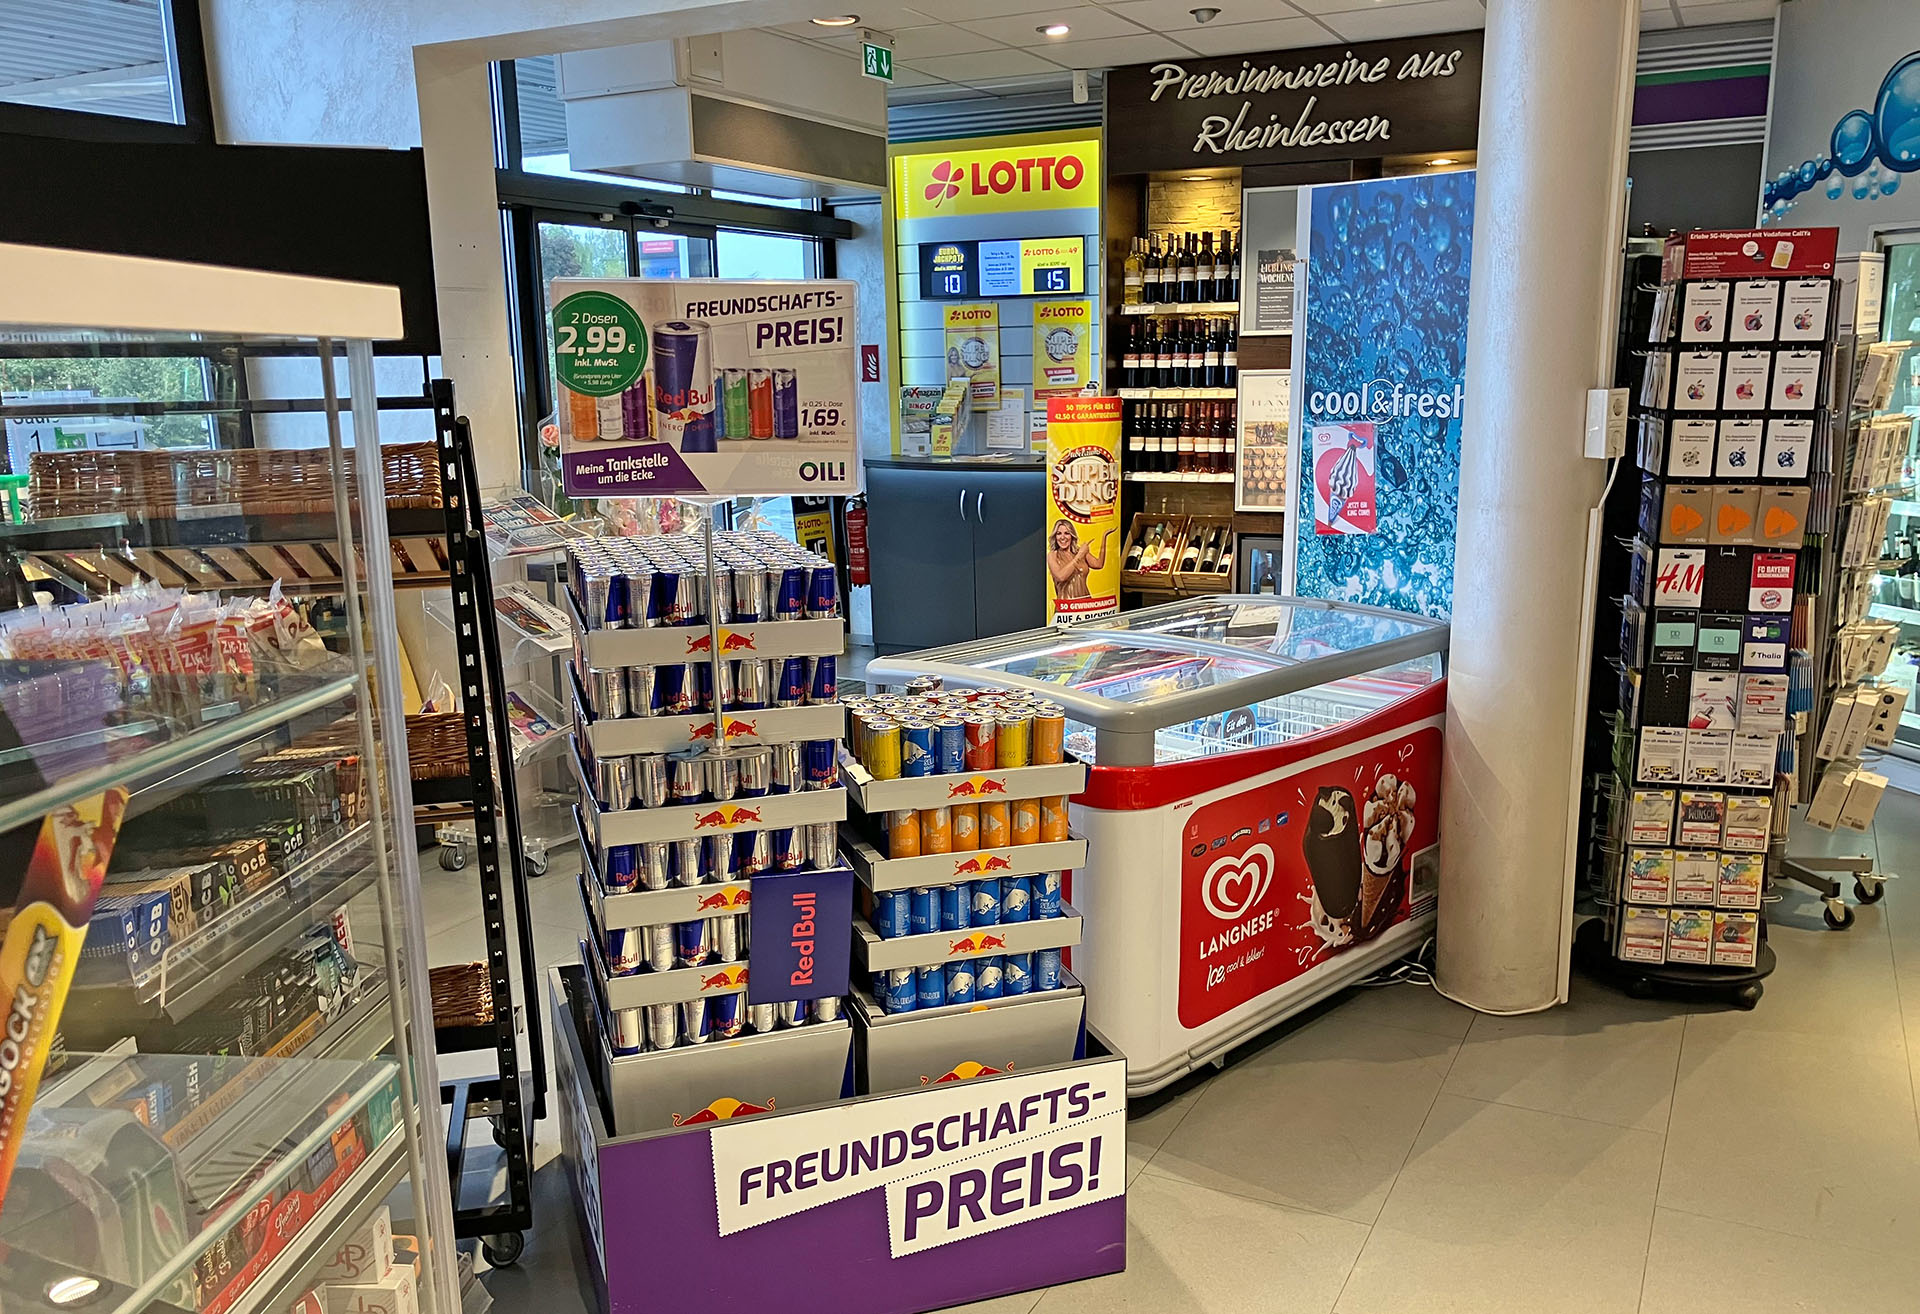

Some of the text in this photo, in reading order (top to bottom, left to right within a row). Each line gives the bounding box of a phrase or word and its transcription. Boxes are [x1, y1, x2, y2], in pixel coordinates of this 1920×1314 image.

[1150, 48, 1462, 101] Premiumweine aus
[1193, 96, 1391, 154] Rheinhessen
[972, 155, 1084, 196] LOTTO
[1032, 248, 1054, 256] LOTTO
[944, 274, 961, 293] 10
[1047, 270, 1064, 290] 15
[686, 290, 843, 319] FREUNDSCHAFTS-
[962, 310, 992, 320] LOTTO
[1053, 307, 1084, 317] LOTTO
[571, 313, 618, 324] 2 Dosen
[557, 326, 636, 356] 2,99 €
[756, 316, 844, 349] PREIS!
[575, 358, 619, 367] inkl. MwSt.
[656, 385, 713, 406] Red Bull
[801, 409, 839, 428] 1,69
[576, 453, 669, 475] Meine Tankstelle
[799, 461, 845, 481] OIL!
[1051, 462, 1119, 484] SUPER
[598, 470, 656, 484] um die Ecke.
[1055, 481, 1116, 501] DING
[803, 519, 821, 529] LOTTO
[1656, 563, 1705, 595] H&M
[674, 602, 692, 613] Bull
[1057, 615, 1072, 623] AUF
[1757, 652, 1782, 660] Thalia
[284, 832, 304, 855] OCB
[241, 852, 267, 876] OCB
[173, 885, 185, 924] OCB
[201, 872, 214, 922] OCB
[149, 902, 163, 956] OCB
[790, 892, 816, 986] Red Bull
[1200, 909, 1274, 960] LANGNESE
[125, 920, 139, 963] OCB
[620, 952, 638, 965] Bull
[739, 1081, 1107, 1206] FREUNDSCHAFTS-
[903, 1135, 1103, 1242] PREIS!
